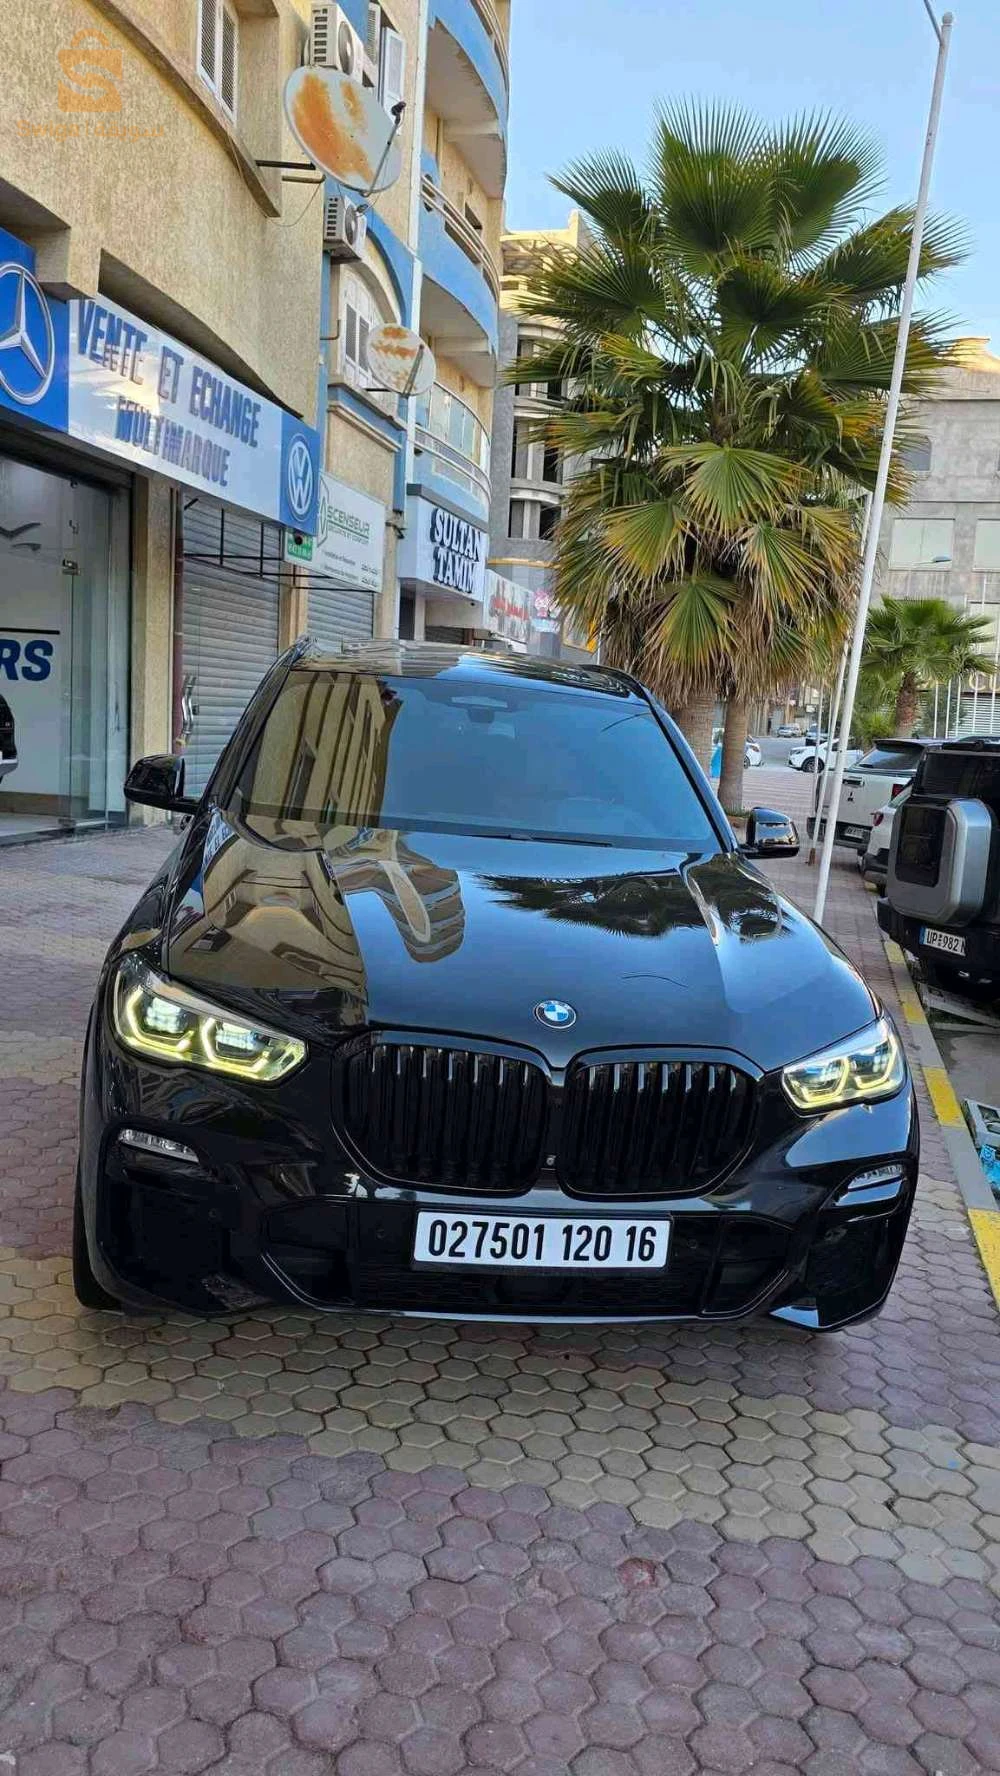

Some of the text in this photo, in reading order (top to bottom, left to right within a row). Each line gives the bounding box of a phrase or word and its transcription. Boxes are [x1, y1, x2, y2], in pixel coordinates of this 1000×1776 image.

[77, 299, 262, 449] VENTE ET ECHANGE
[430, 507, 481, 562] SULTAN
[433, 546, 475, 594] TAMIM
[428, 1219, 657, 1262] 027501 120 16
